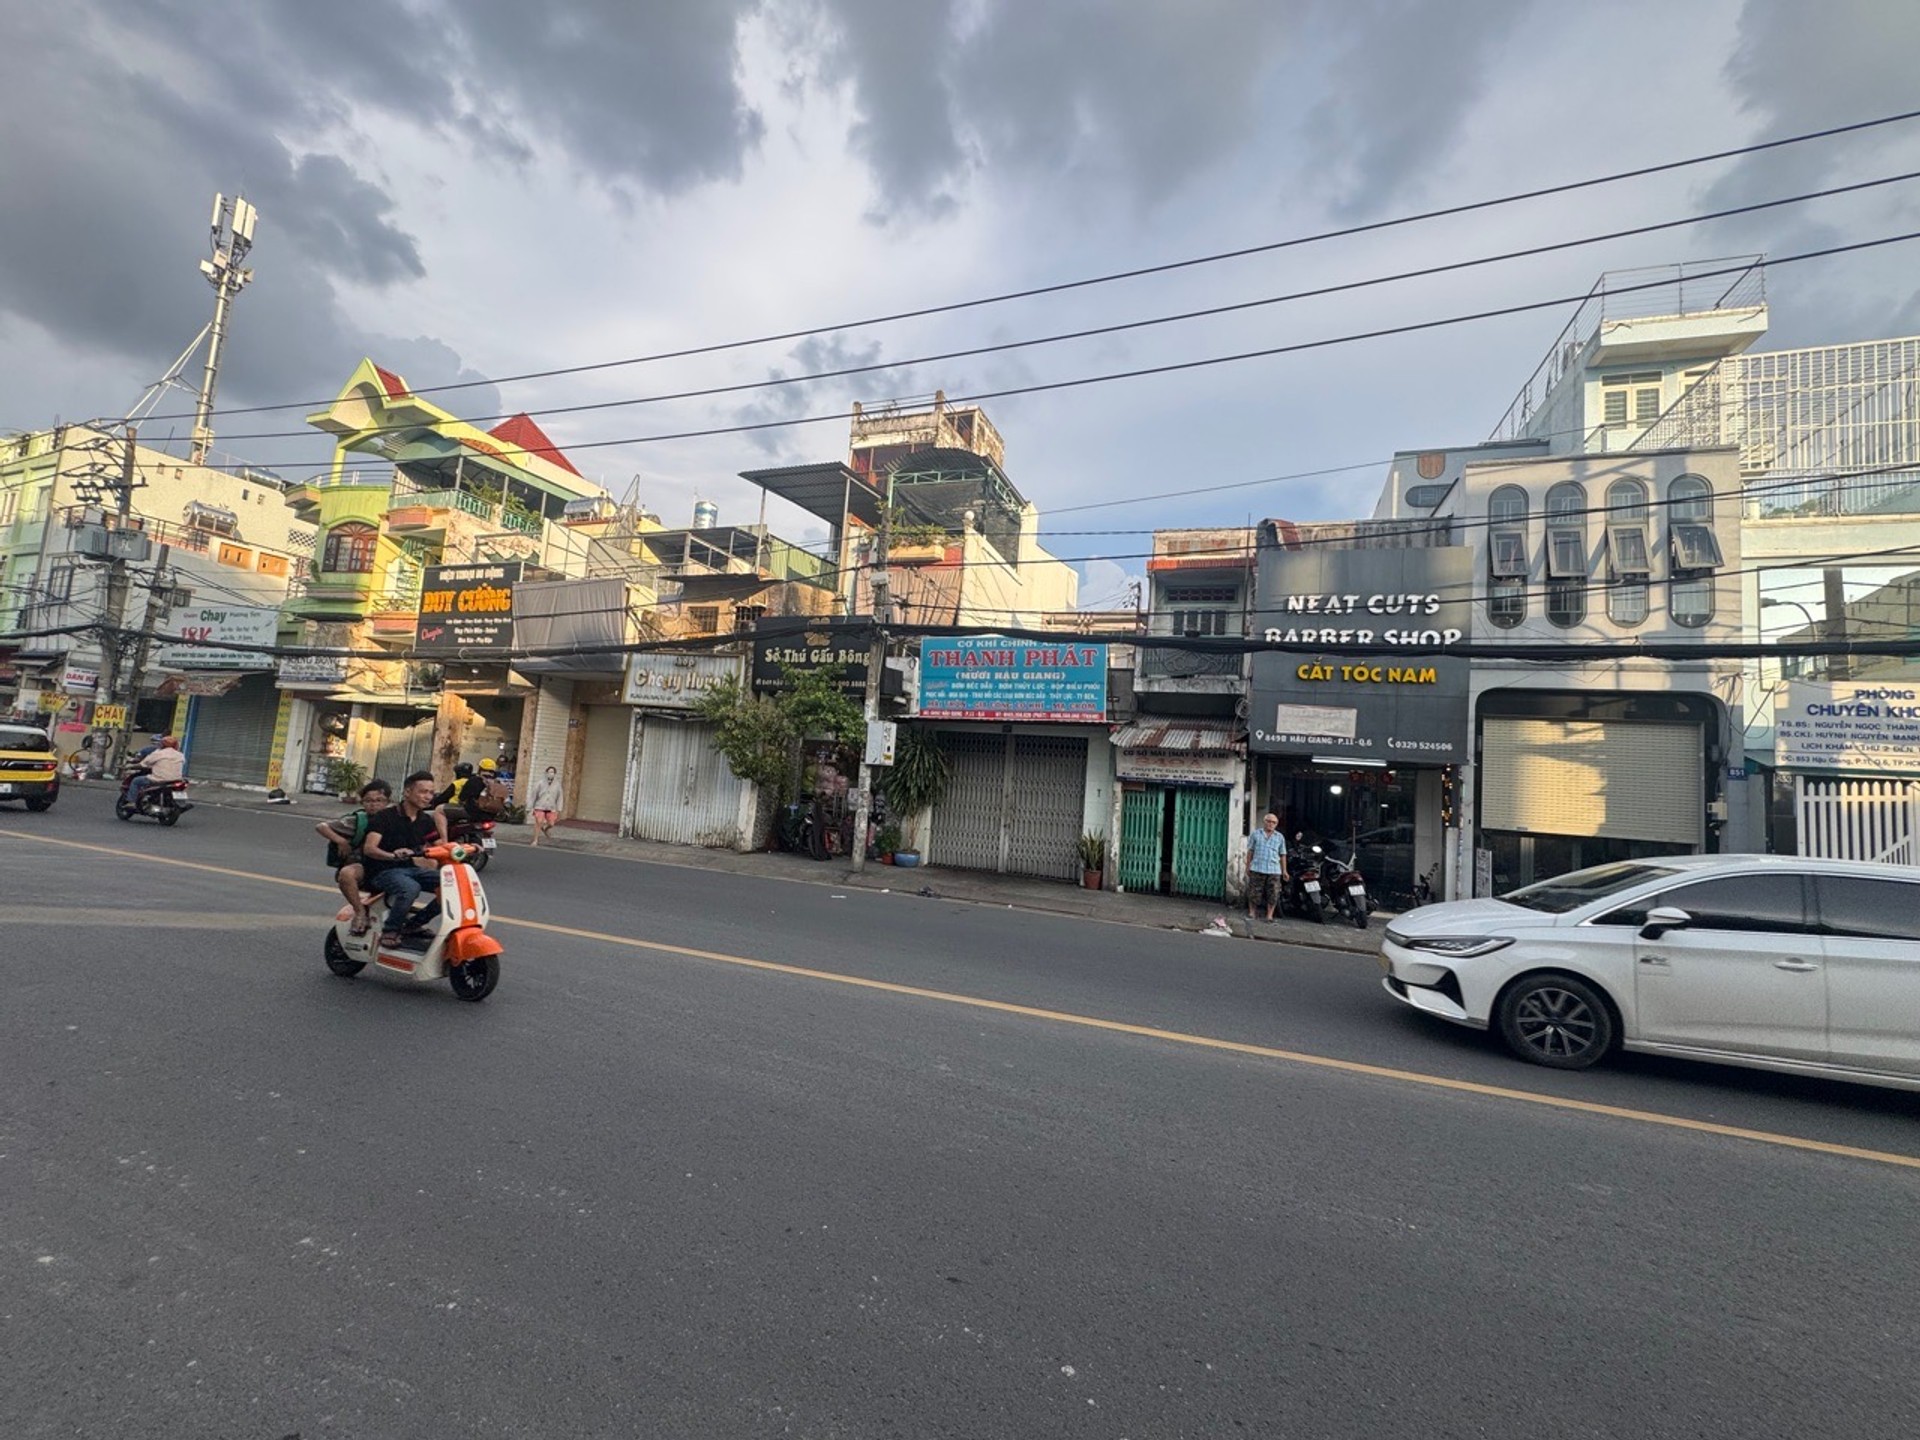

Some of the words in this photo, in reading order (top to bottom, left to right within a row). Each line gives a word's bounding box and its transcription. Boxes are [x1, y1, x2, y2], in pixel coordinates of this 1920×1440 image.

[422, 591, 457, 613] DUY
[1287, 594, 1360, 614] NEAT
[1366, 593, 1441, 614] CUTS
[200, 609, 227, 624] Chay
[1264, 628, 1374, 644] BARBER
[1383, 628, 1463, 645] SHOP
[783, 648, 807, 663] Thú
[810, 647, 834, 663] Gấu
[838, 649, 870, 667] Bông
[928, 650, 1016, 671] THẠNH
[1025, 645, 1098, 667] PHÁT
[1023, 671, 1066, 680] GIANG)
[1297, 656, 1334, 680] CẮT
[1341, 661, 1382, 681] TÓC
[1388, 667, 1438, 684] NAM
[1854, 686, 1916, 700] PHÒNG
[95, 705, 125, 719] CHAY
[1806, 703, 1879, 717] CHUYÊN
